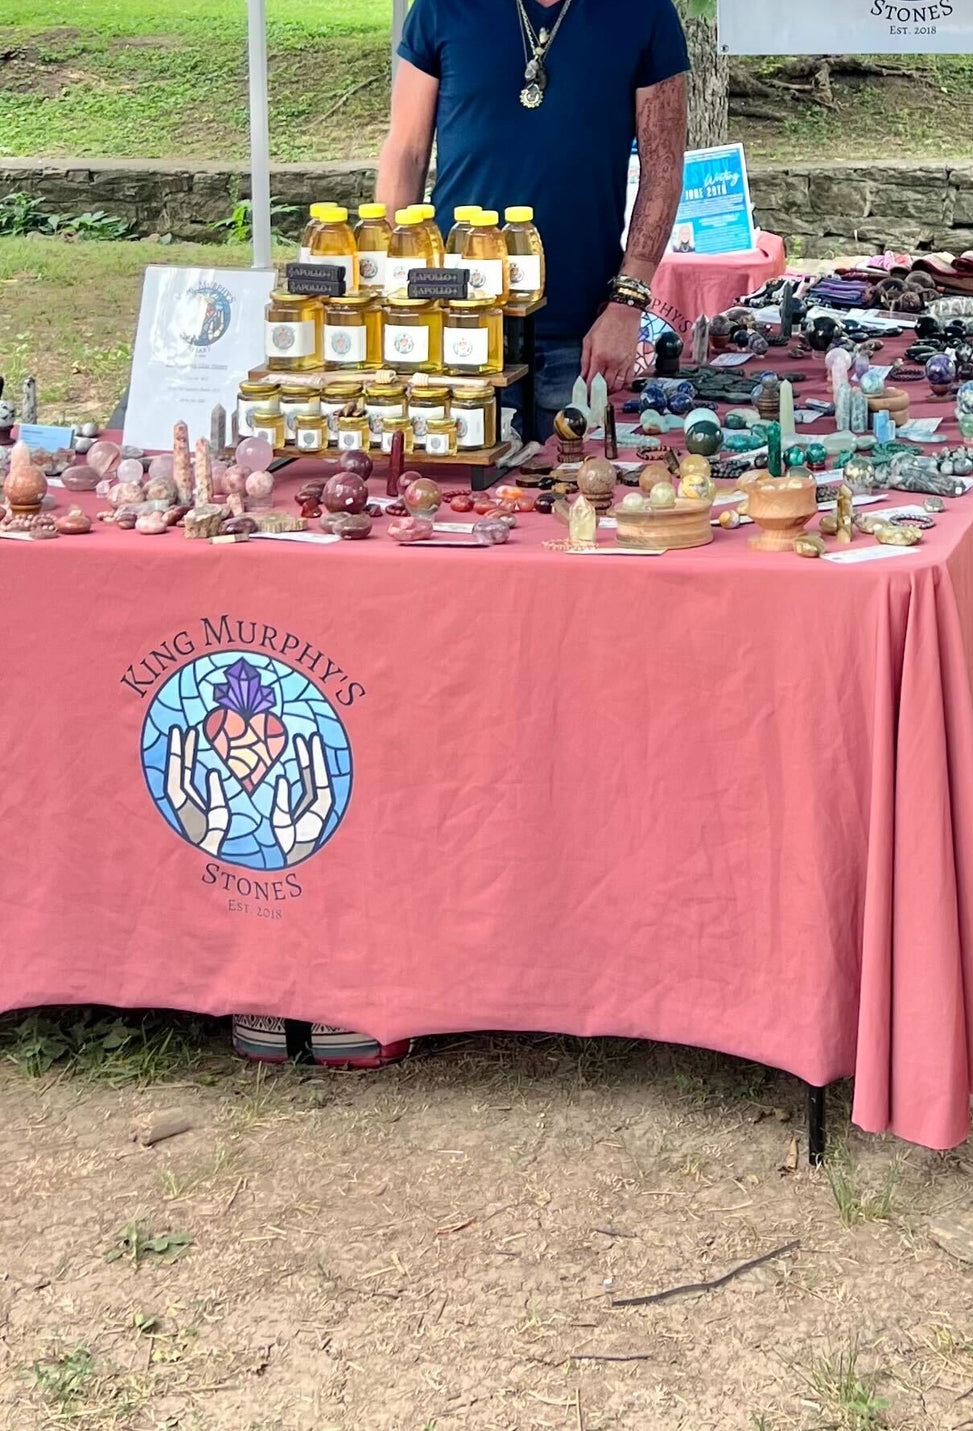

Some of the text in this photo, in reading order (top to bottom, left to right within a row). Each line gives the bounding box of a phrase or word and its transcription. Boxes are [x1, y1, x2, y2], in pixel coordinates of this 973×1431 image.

[914, 25, 937, 35] 2018
[651, 297, 694, 333] PHY'S
[120, 614, 366, 708] KING MURPHY'S
[201, 863, 303, 902] STONES
[257, 907, 282, 920] 2018
